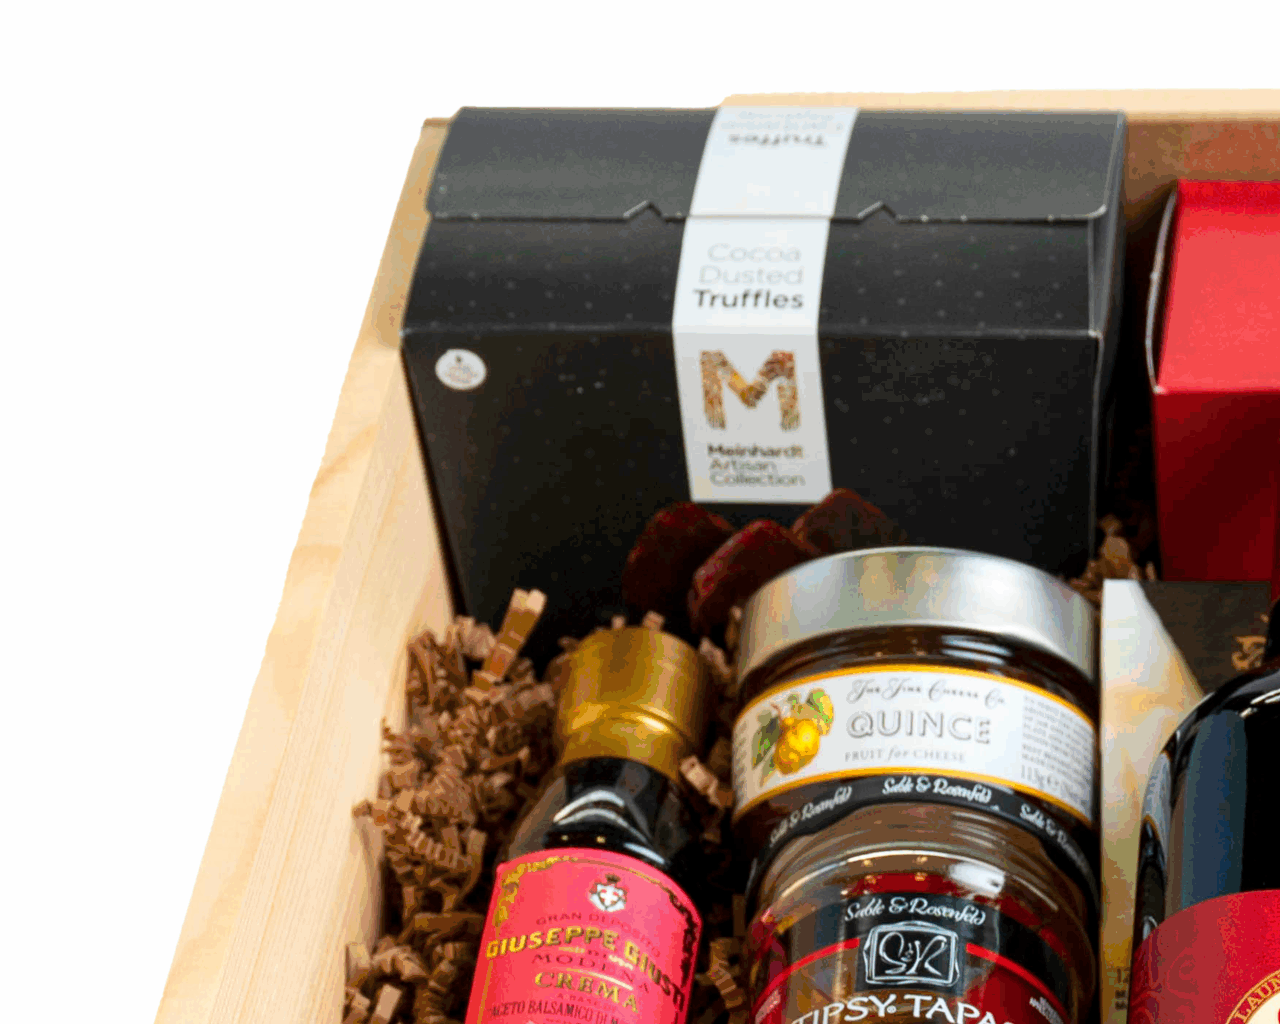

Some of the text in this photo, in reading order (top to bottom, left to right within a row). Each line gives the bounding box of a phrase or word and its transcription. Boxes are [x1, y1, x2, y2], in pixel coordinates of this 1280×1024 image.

[707, 242, 802, 262] Cocoa
[699, 265, 804, 285] Dusted
[693, 288, 804, 309] Truffles
[700, 350, 801, 431] M
[846, 709, 991, 744] QUINCE
[845, 748, 883, 762] FRUIT
[486, 926, 619, 960] GIUSEPPE
[534, 972, 639, 1014] CREMA
[528, 1000, 593, 1022] BALSAMICO
